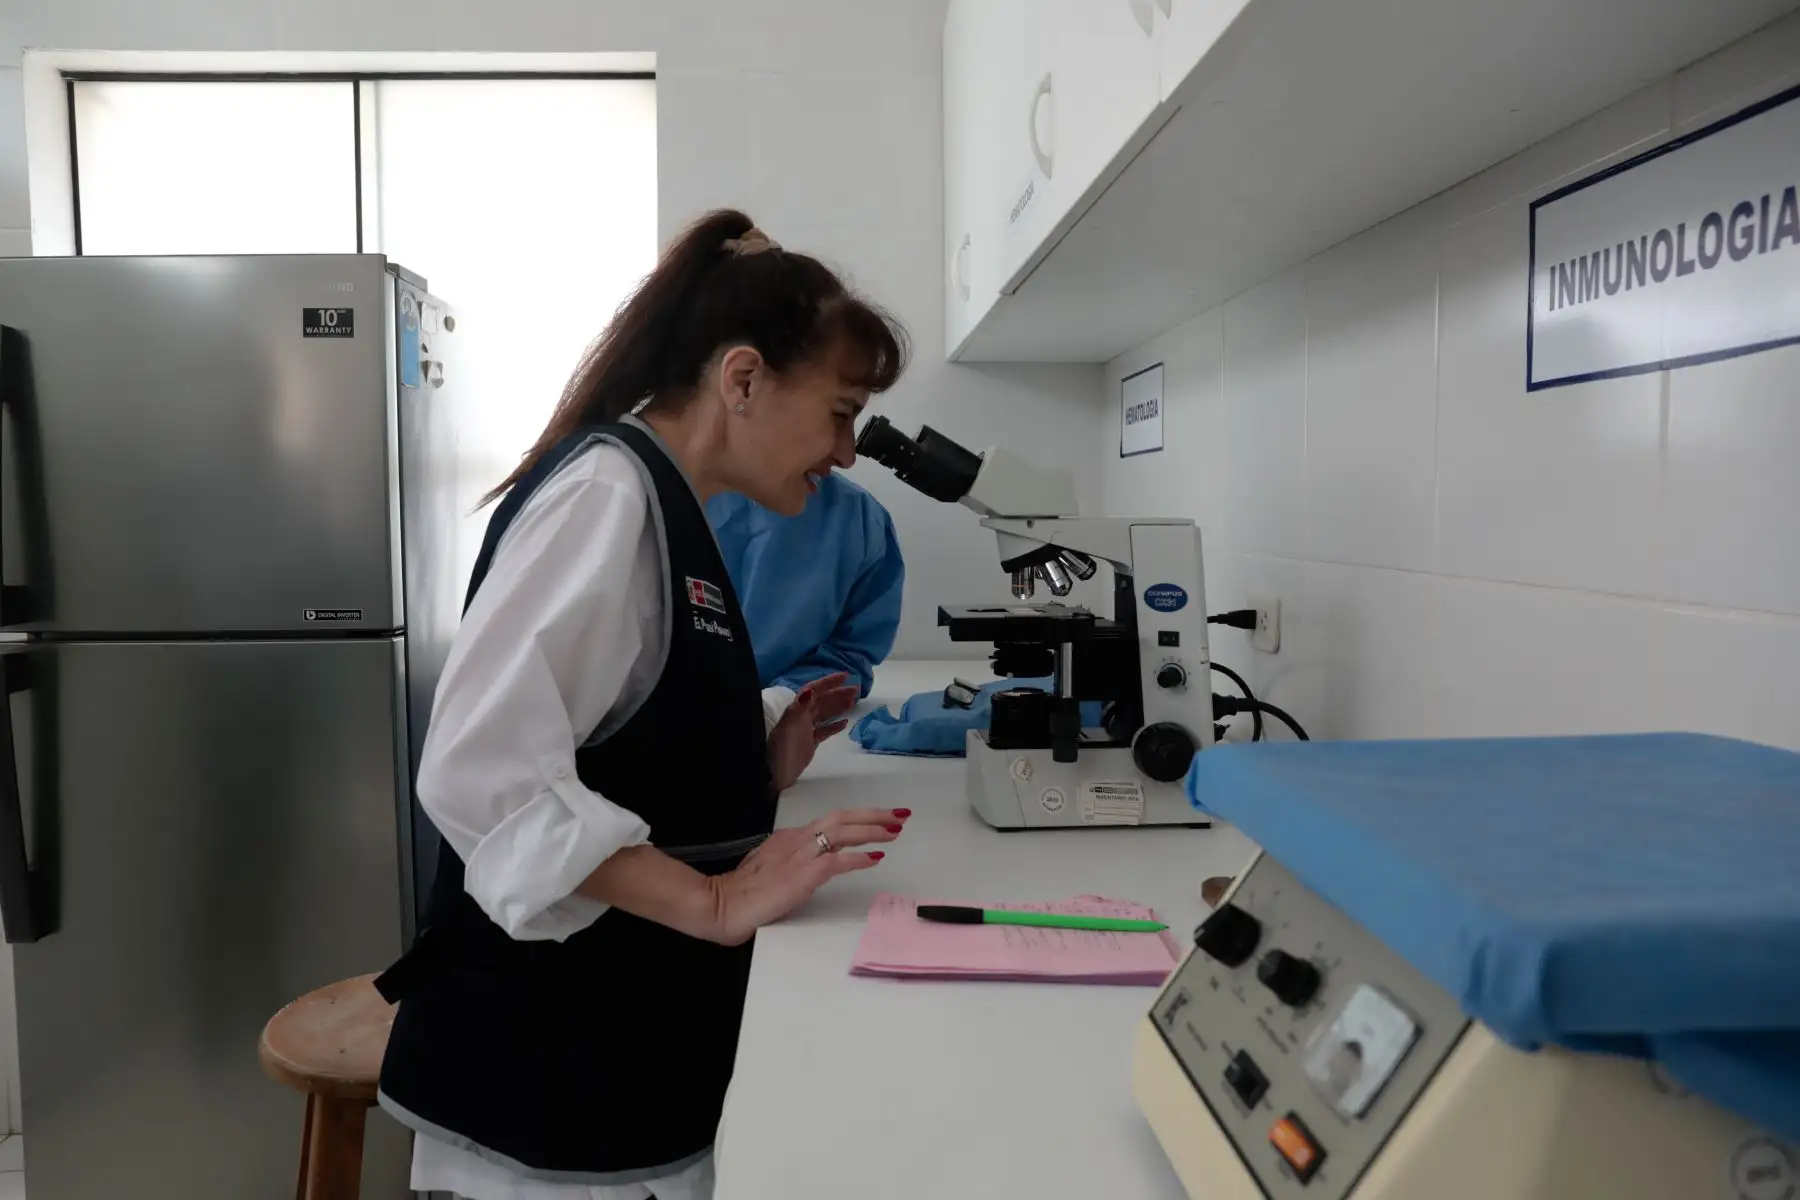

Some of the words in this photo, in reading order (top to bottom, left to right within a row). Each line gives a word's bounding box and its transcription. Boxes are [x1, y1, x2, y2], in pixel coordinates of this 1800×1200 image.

[1549, 184, 1800, 312] INMUNOLOGIA
[318, 309, 338, 326] 10
[305, 326, 352, 334] WARRANTY
[1126, 399, 1159, 425] HEMATOLOGIA
